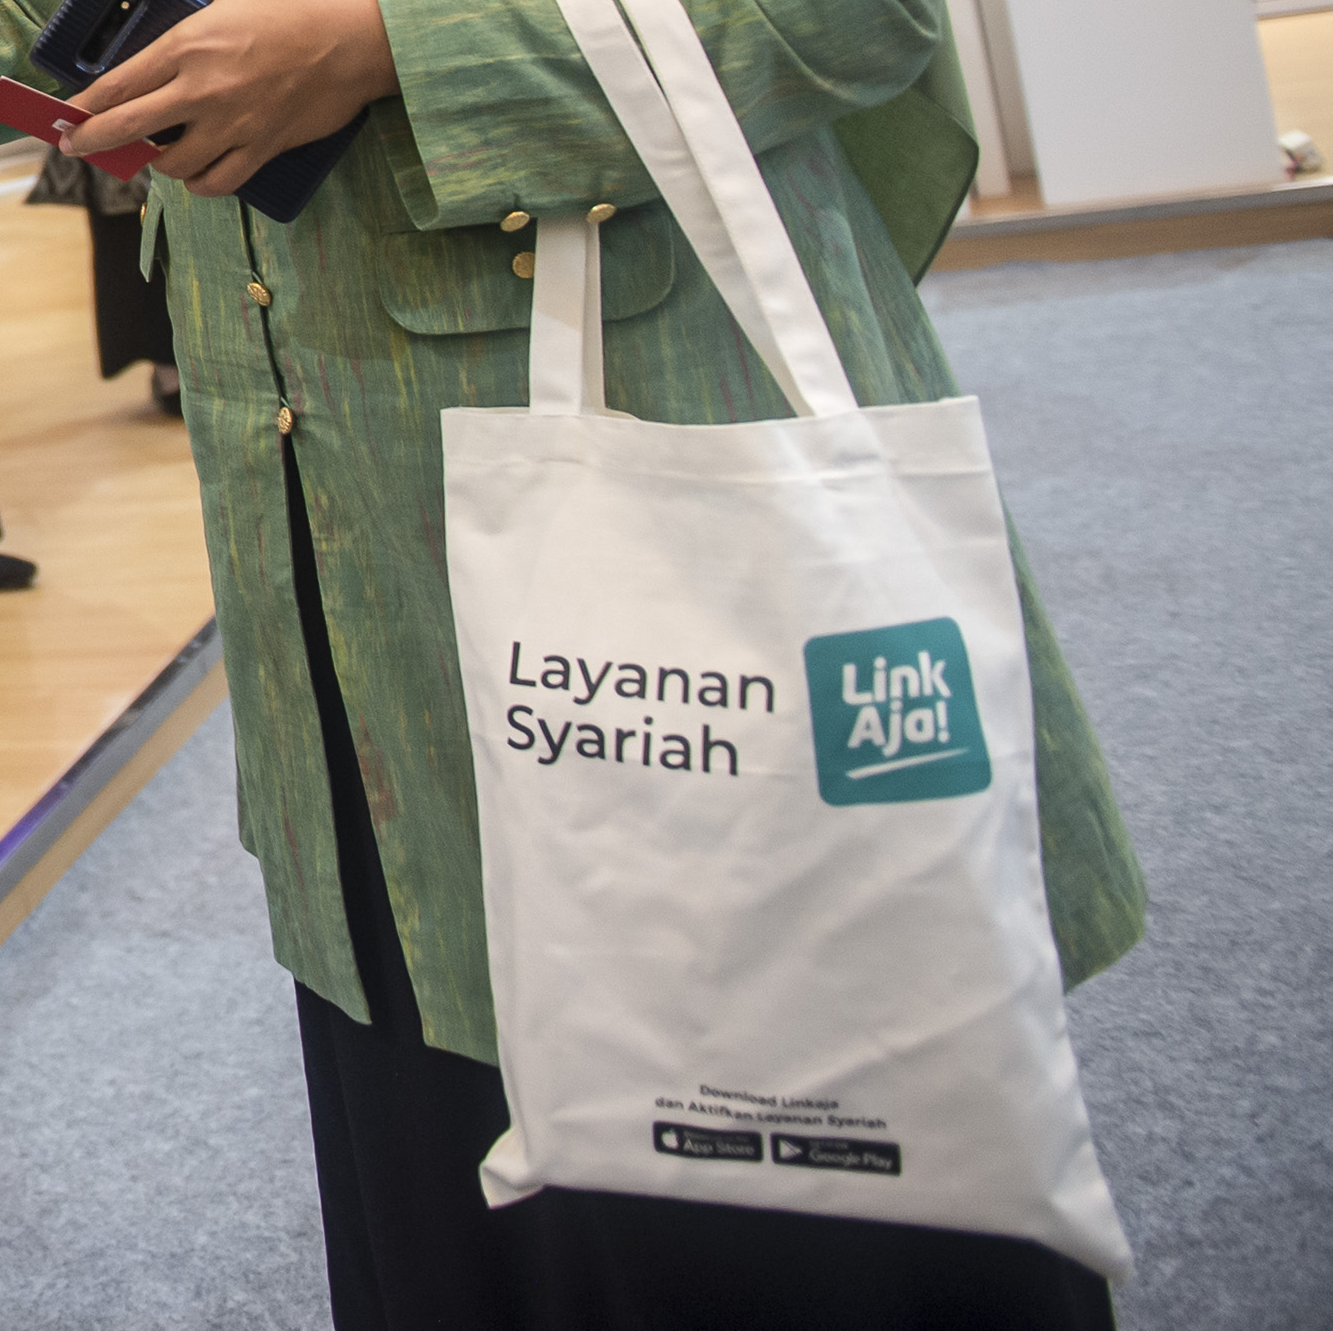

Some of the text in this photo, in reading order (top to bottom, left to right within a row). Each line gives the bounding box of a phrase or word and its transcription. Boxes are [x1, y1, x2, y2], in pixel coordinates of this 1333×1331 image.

[508, 641, 776, 713] Layanan
[842, 650, 954, 706] Link
[506, 704, 740, 777] Syariah
[847, 702, 950, 757] Aja!
[655, 1096, 683, 1110] dan
[688, 1101, 754, 1121] Aktifkan
[827, 1114, 887, 1130] Syariah
[699, 1084, 777, 1107] Download
[683, 1137, 713, 1155] App
[716, 1140, 755, 1155] Store
[863, 1150, 893, 1169] Play
